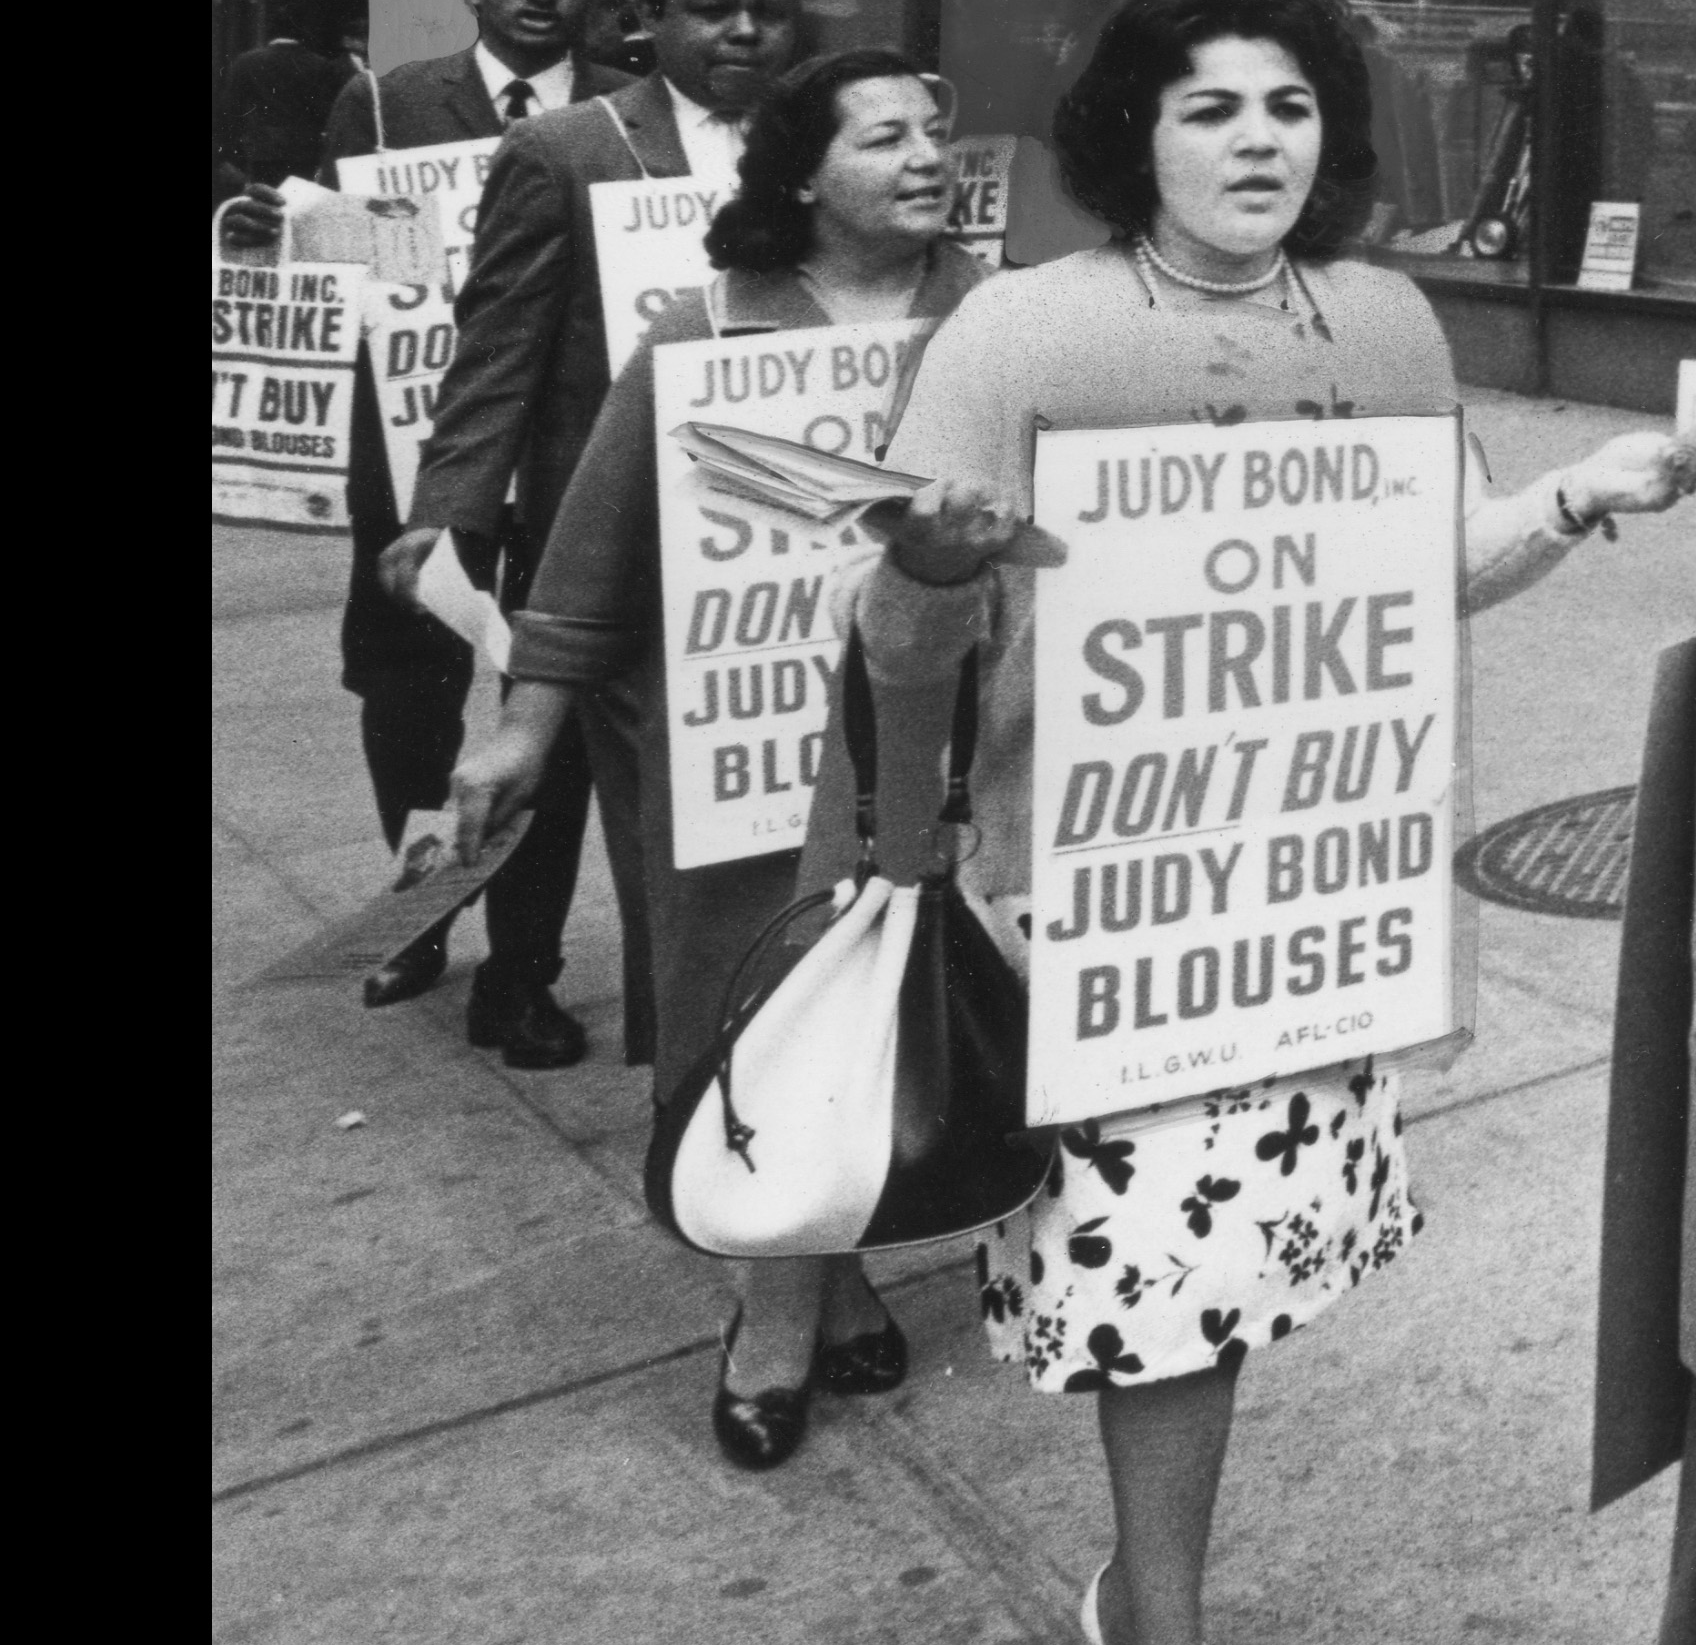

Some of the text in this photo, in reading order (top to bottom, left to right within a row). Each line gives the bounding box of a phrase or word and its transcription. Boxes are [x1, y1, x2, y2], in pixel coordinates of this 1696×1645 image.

[218, 267, 346, 304] BOND INC.
[211, 298, 345, 352] STRIKE
[258, 376, 337, 427] BUY
[690, 347, 815, 408] JUDY
[250, 428, 337, 459] BLOUSES
[1077, 452, 1228, 524] JUDY
[1243, 443, 1380, 510] BOND,
[1203, 532, 1316, 594] ON
[1081, 590, 1414, 727] STRIKE
[1052, 713, 1437, 849] DON'T BUY
[1045, 811, 1434, 942] JUDY BOND
[1075, 906, 1414, 1042] BLOUSES
[1275, 1011, 1374, 1051] AFL-CIO
